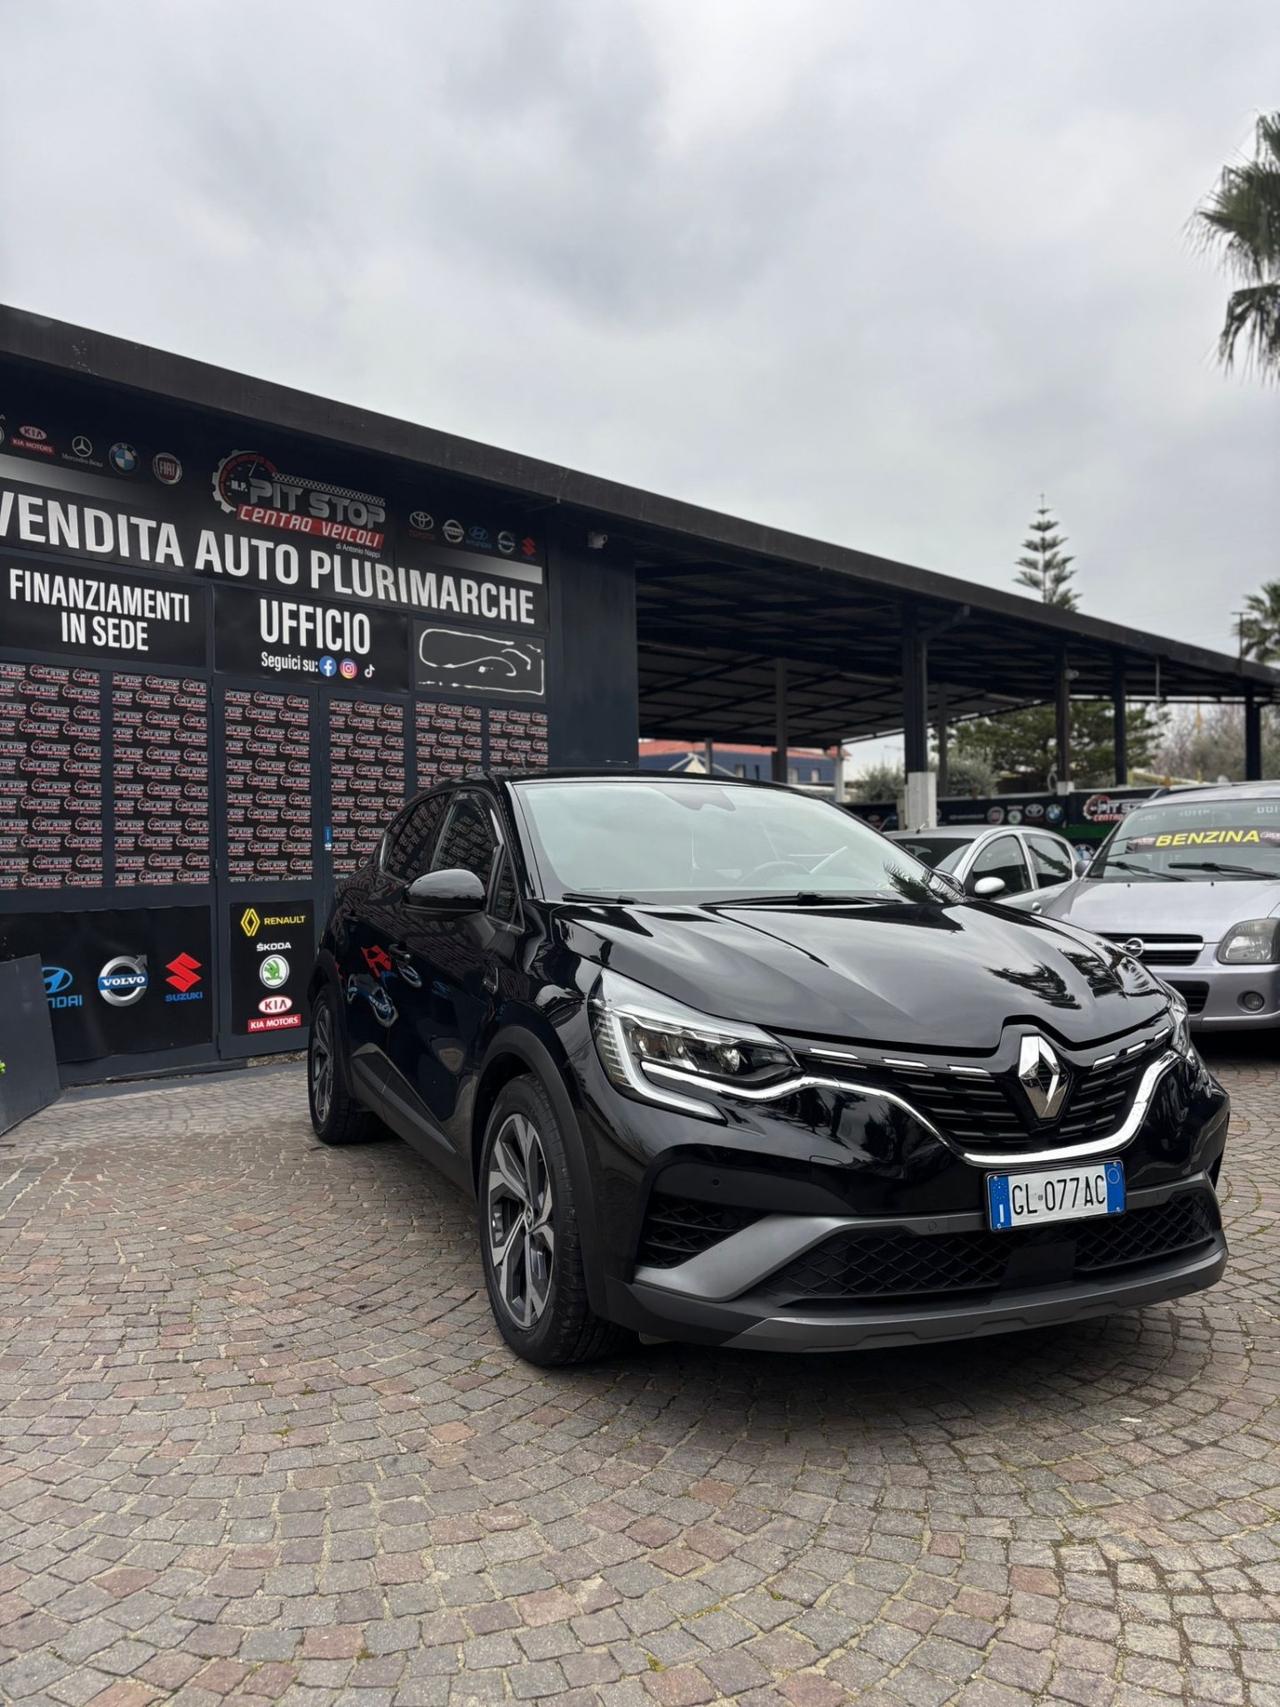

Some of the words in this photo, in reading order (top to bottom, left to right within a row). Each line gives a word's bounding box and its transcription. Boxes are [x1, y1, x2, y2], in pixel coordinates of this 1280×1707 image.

[23, 427, 43, 438] KIA
[250, 478, 303, 512] PIT
[308, 491, 386, 529] STOP
[195, 529, 300, 585] AUTO
[310, 549, 535, 624] PLURIMARCHE
[9, 568, 190, 623] FINANZIAMENTI
[61, 611, 86, 644] IN
[92, 616, 149, 651] SEDE
[259, 598, 371, 655] UFFICIO
[261, 651, 301, 672] Seguici
[302, 659, 319, 672] su:
[1155, 830, 1260, 847] BENZINA
[264, 915, 306, 926] RENAULT
[256, 941, 292, 952] ŠKODA
[103, 974, 146, 987] VOLVO
[165, 991, 203, 1002] SUZUKI
[264, 999, 287, 1011] KIA
[250, 1020, 264, 1029] KIA
[266, 1016, 298, 1027] MOTORS
[1012, 1183, 1038, 1216] GL
[1044, 1174, 1106, 1211] 077AC
